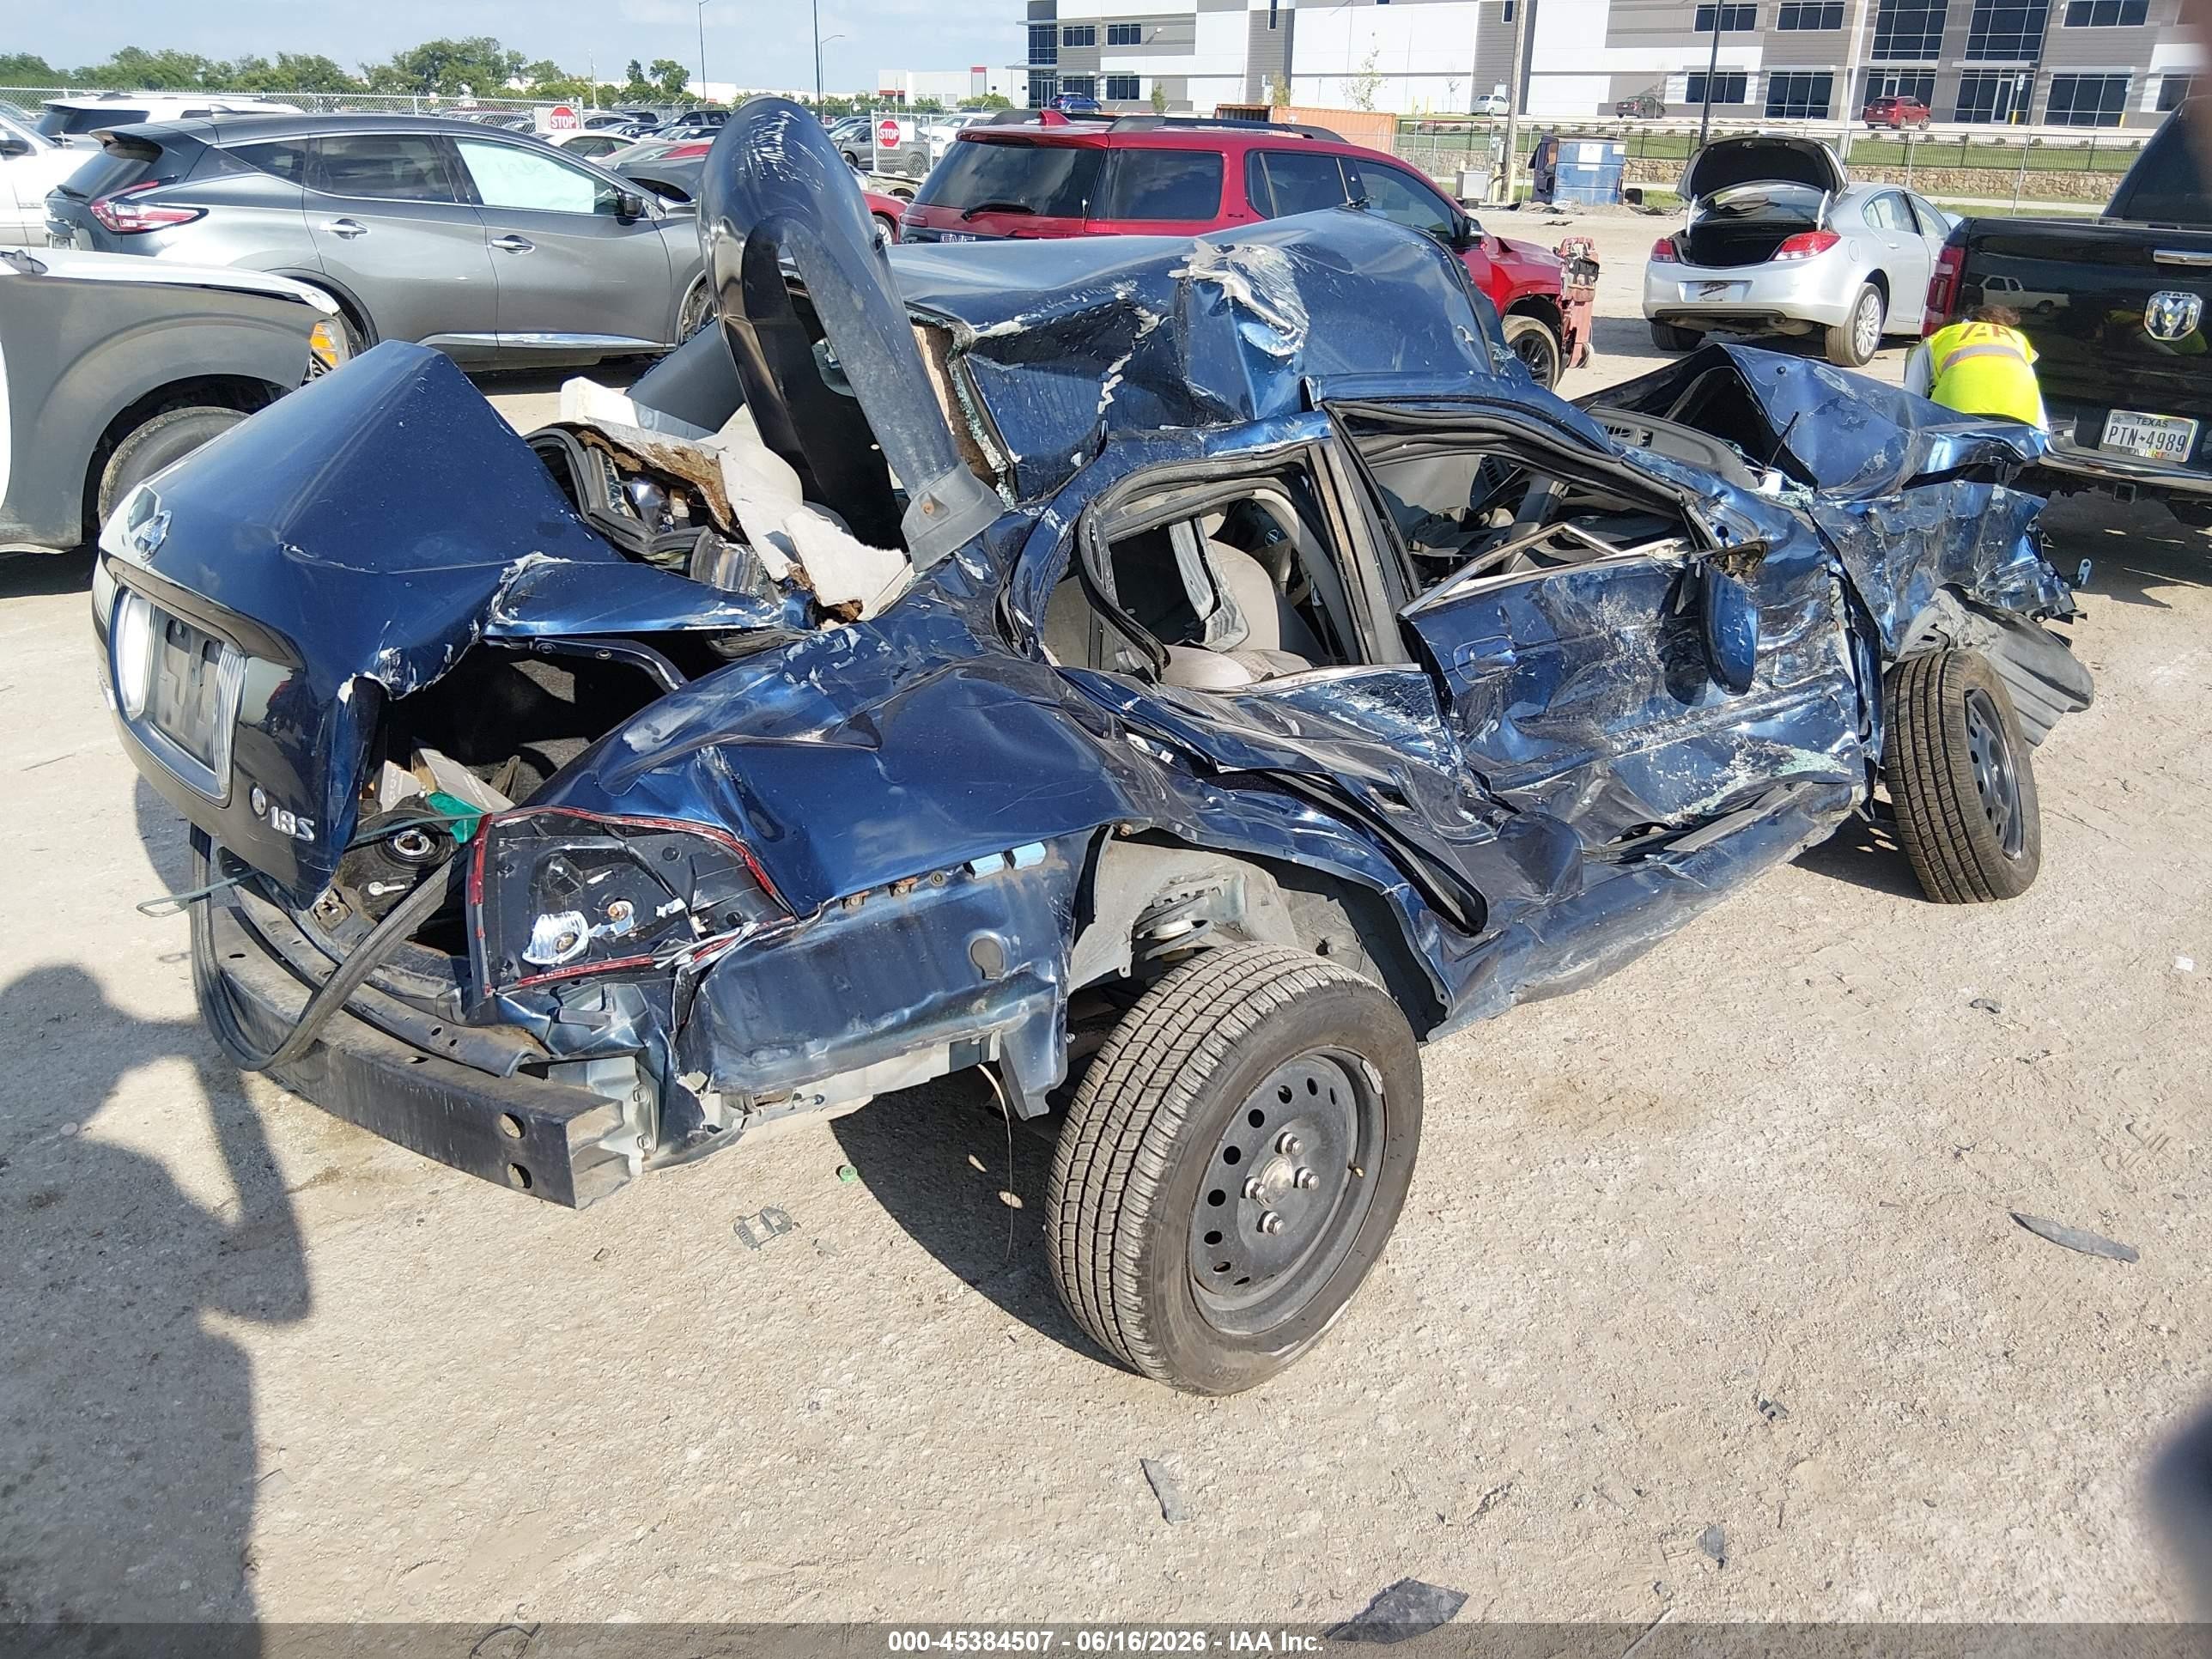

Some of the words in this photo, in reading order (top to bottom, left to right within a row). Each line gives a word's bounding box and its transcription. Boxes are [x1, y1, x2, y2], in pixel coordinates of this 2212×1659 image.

[550, 115, 576, 129] STOP
[879, 128, 900, 140] STOP
[2136, 416, 2169, 428] TEXAS
